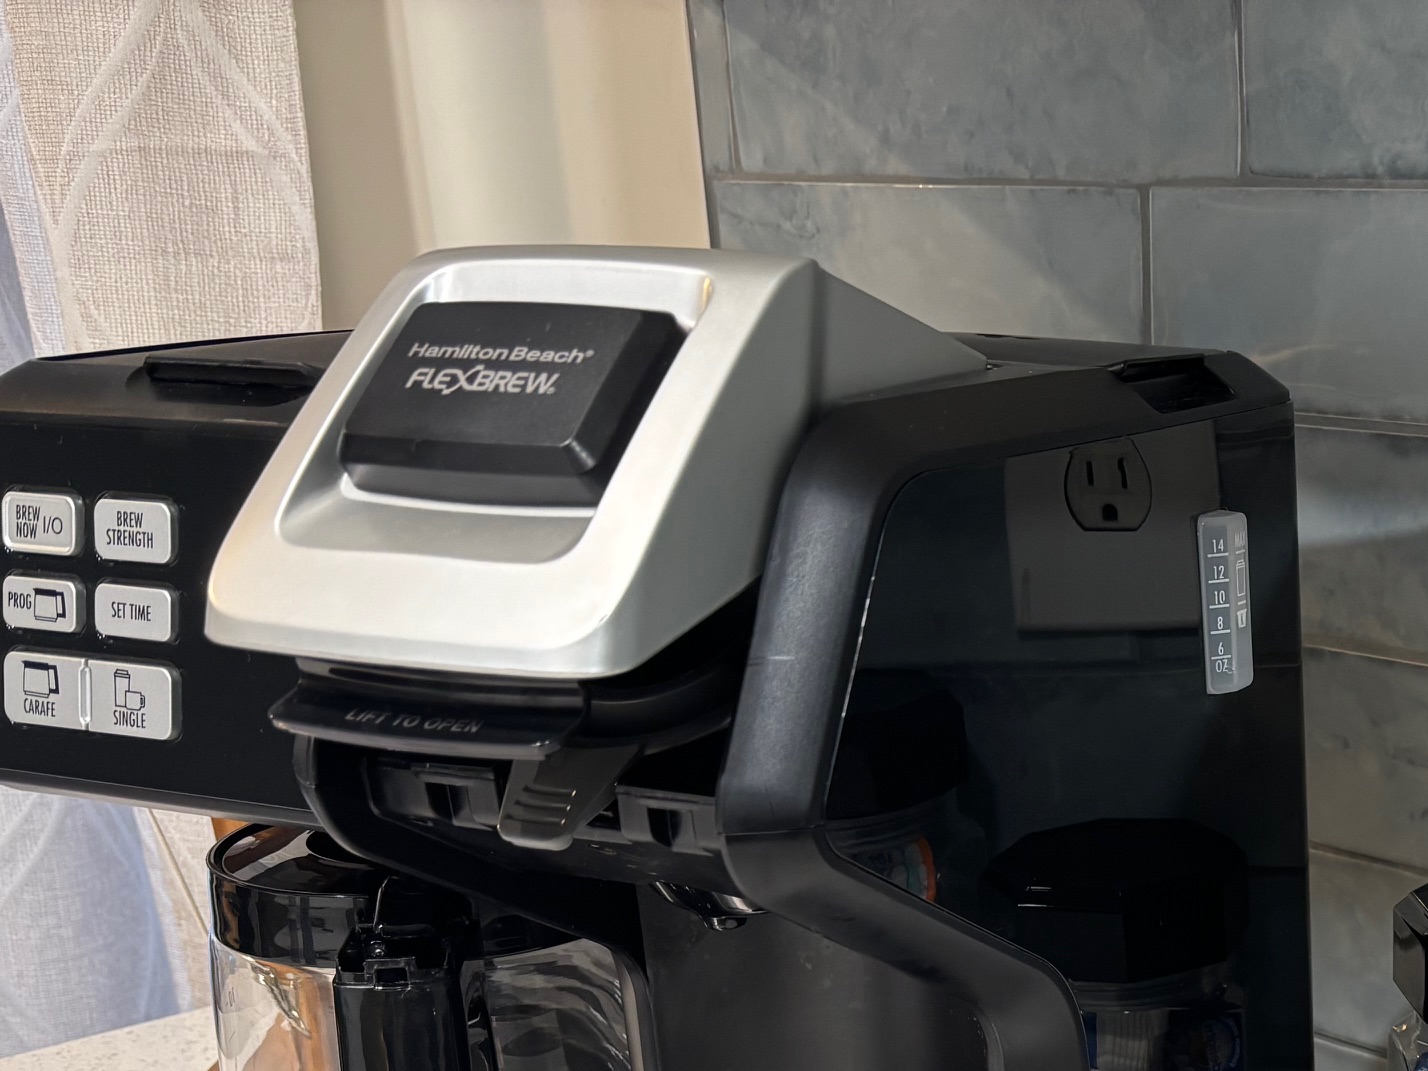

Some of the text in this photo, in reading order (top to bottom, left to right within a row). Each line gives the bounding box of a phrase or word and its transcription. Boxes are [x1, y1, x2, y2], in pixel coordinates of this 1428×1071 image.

[408, 343, 507, 361] Hamilton
[16, 504, 40, 522] BREW
[116, 511, 143, 528] BREW
[16, 522, 37, 539] NOW
[106, 529, 154, 549] STRENGTH
[1212, 539, 1224, 553] 14
[1213, 565, 1225, 579] 12
[8, 592, 32, 610] PROG
[1214, 590, 1226, 604] 10
[111, 601, 151, 622] SET TIME
[1217, 617, 1224, 630] 8
[1218, 642, 1224, 655] 6
[23, 698, 56, 718] CARAFE
[113, 710, 146, 729] SINGLE
[345, 708, 485, 734] LIFT TO OPEN
